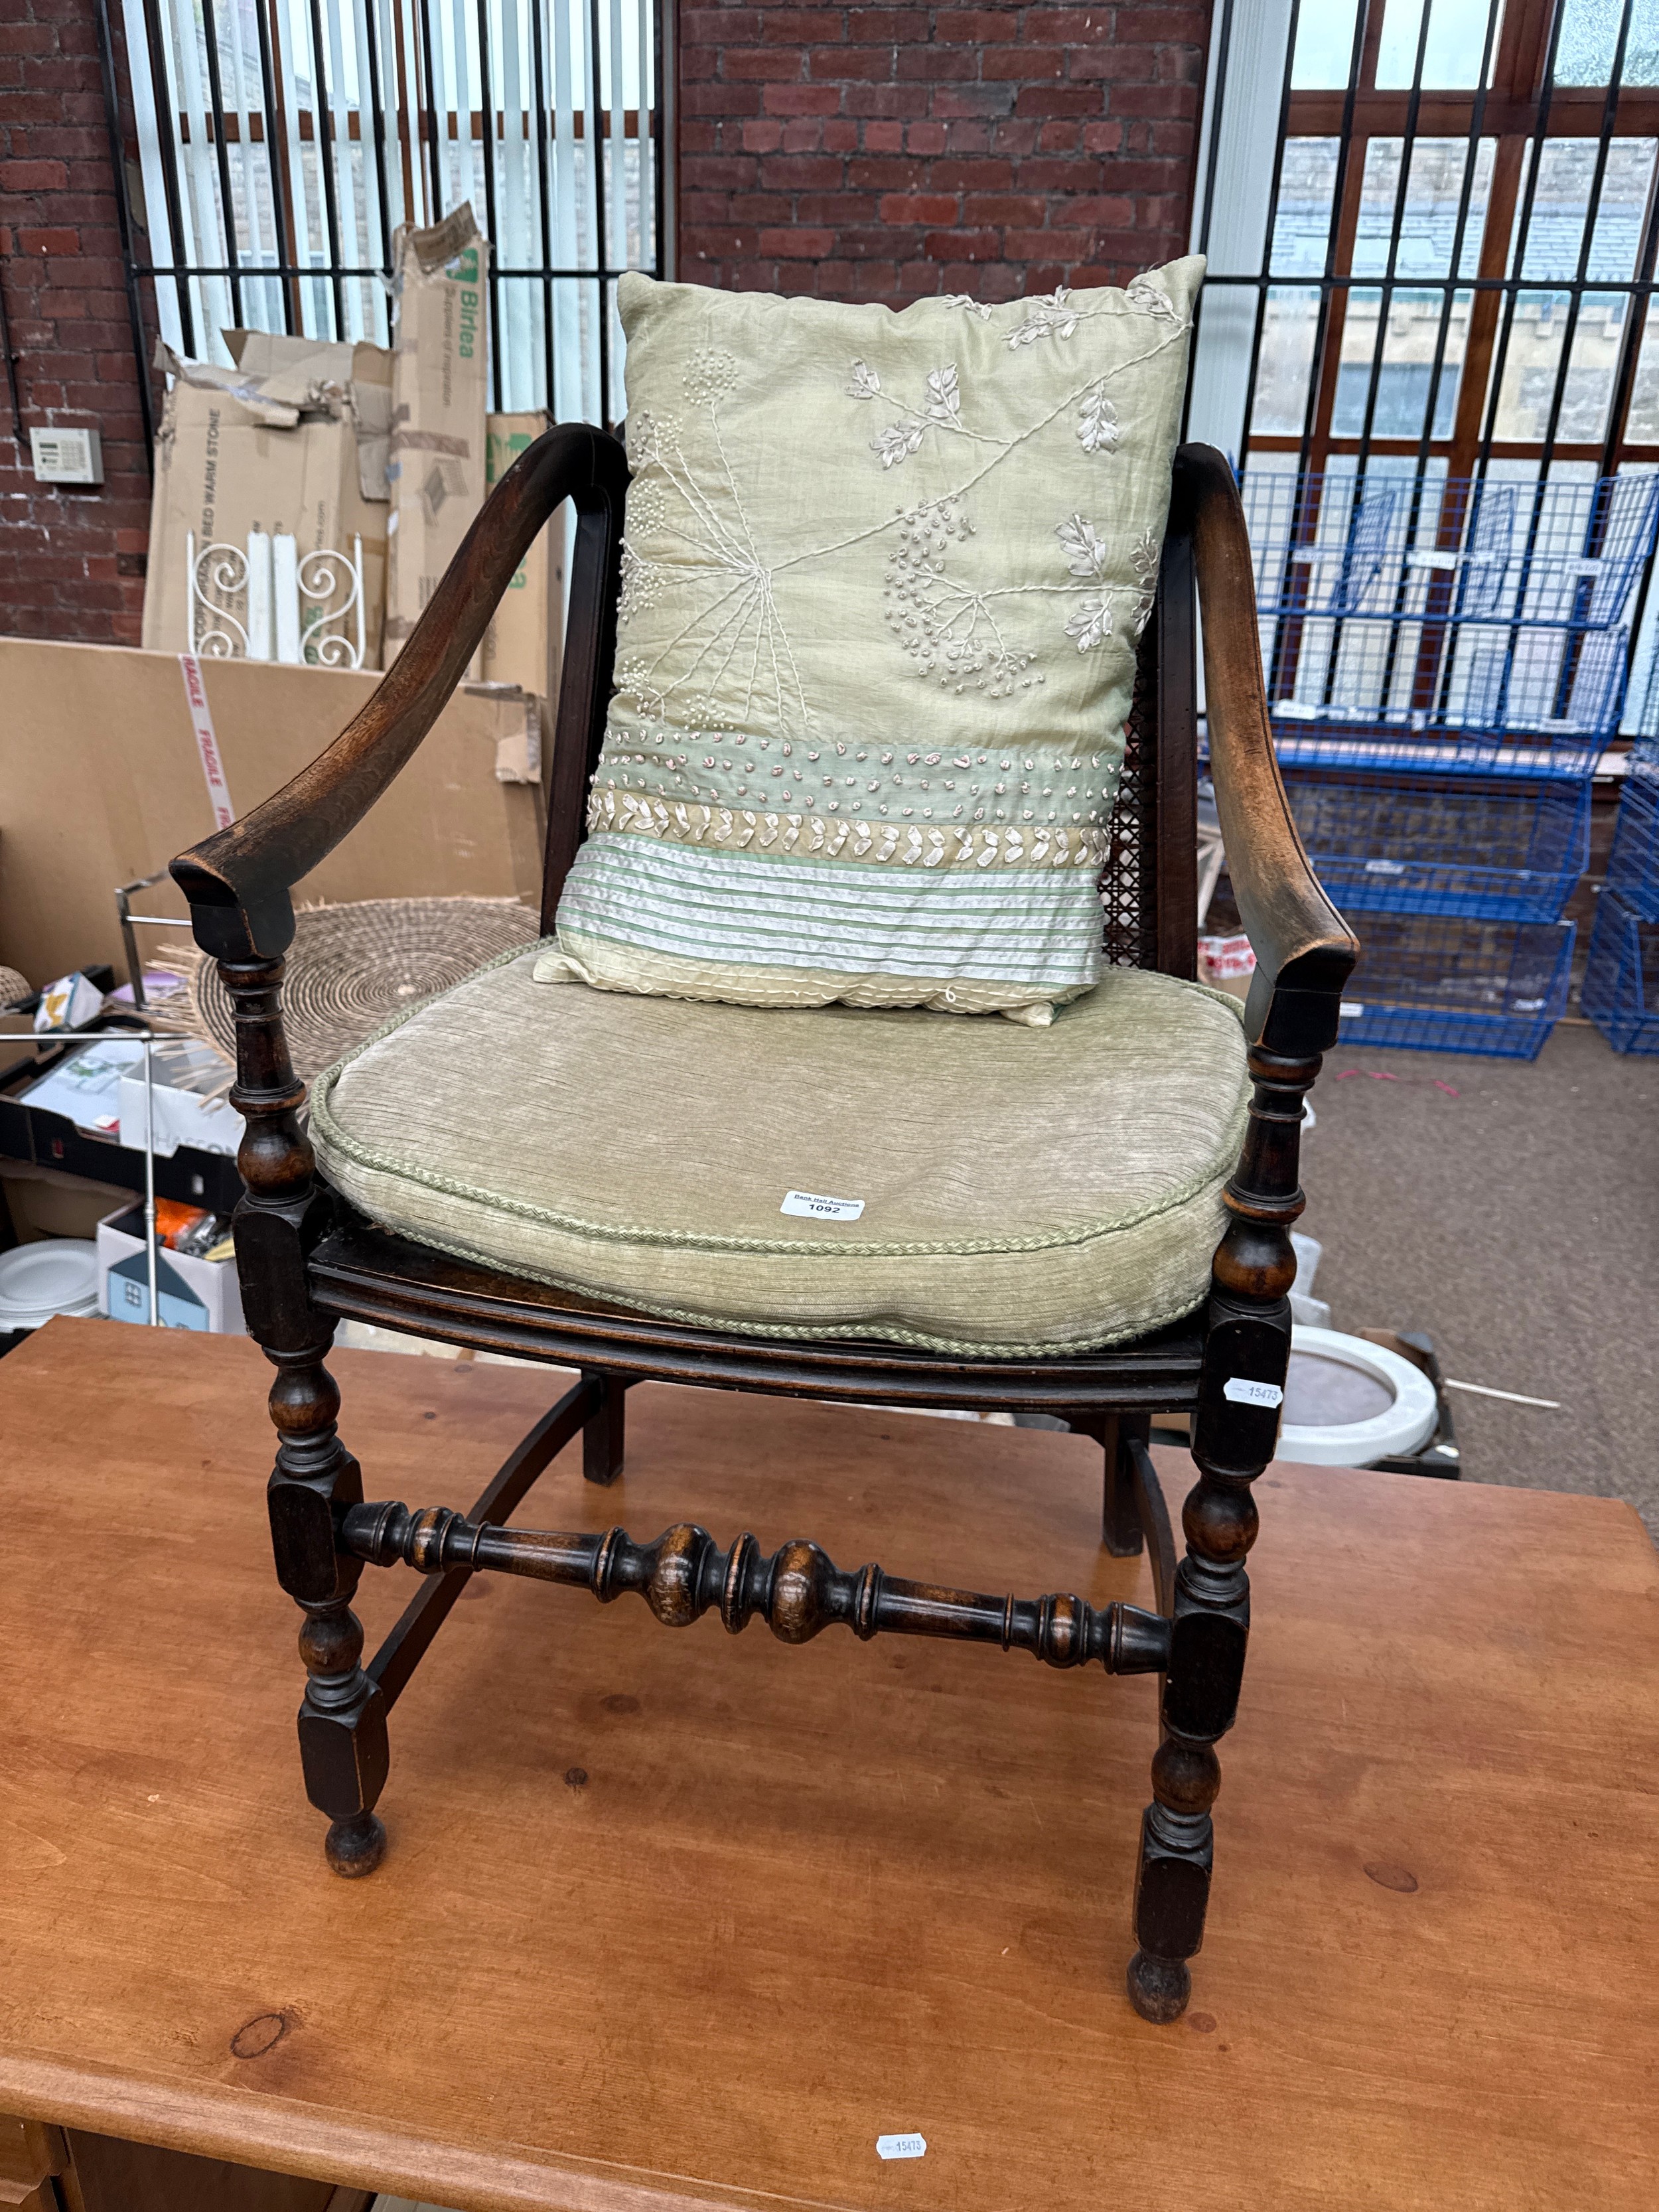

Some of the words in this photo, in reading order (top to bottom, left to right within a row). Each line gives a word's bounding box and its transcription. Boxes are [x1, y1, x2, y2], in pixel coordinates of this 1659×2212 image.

[459, 289, 478, 358] Birlea
[206, 408, 220, 457] STONE
[204, 461, 217, 505] WARM
[202, 506, 214, 537] BED
[183, 656, 204, 707] RAGILE
[198, 729, 223, 786] FRAGILE
[809, 1204, 840, 1213] 1092
[1249, 1386, 1278, 1400] 15473
[896, 2140, 921, 2151] 15473
